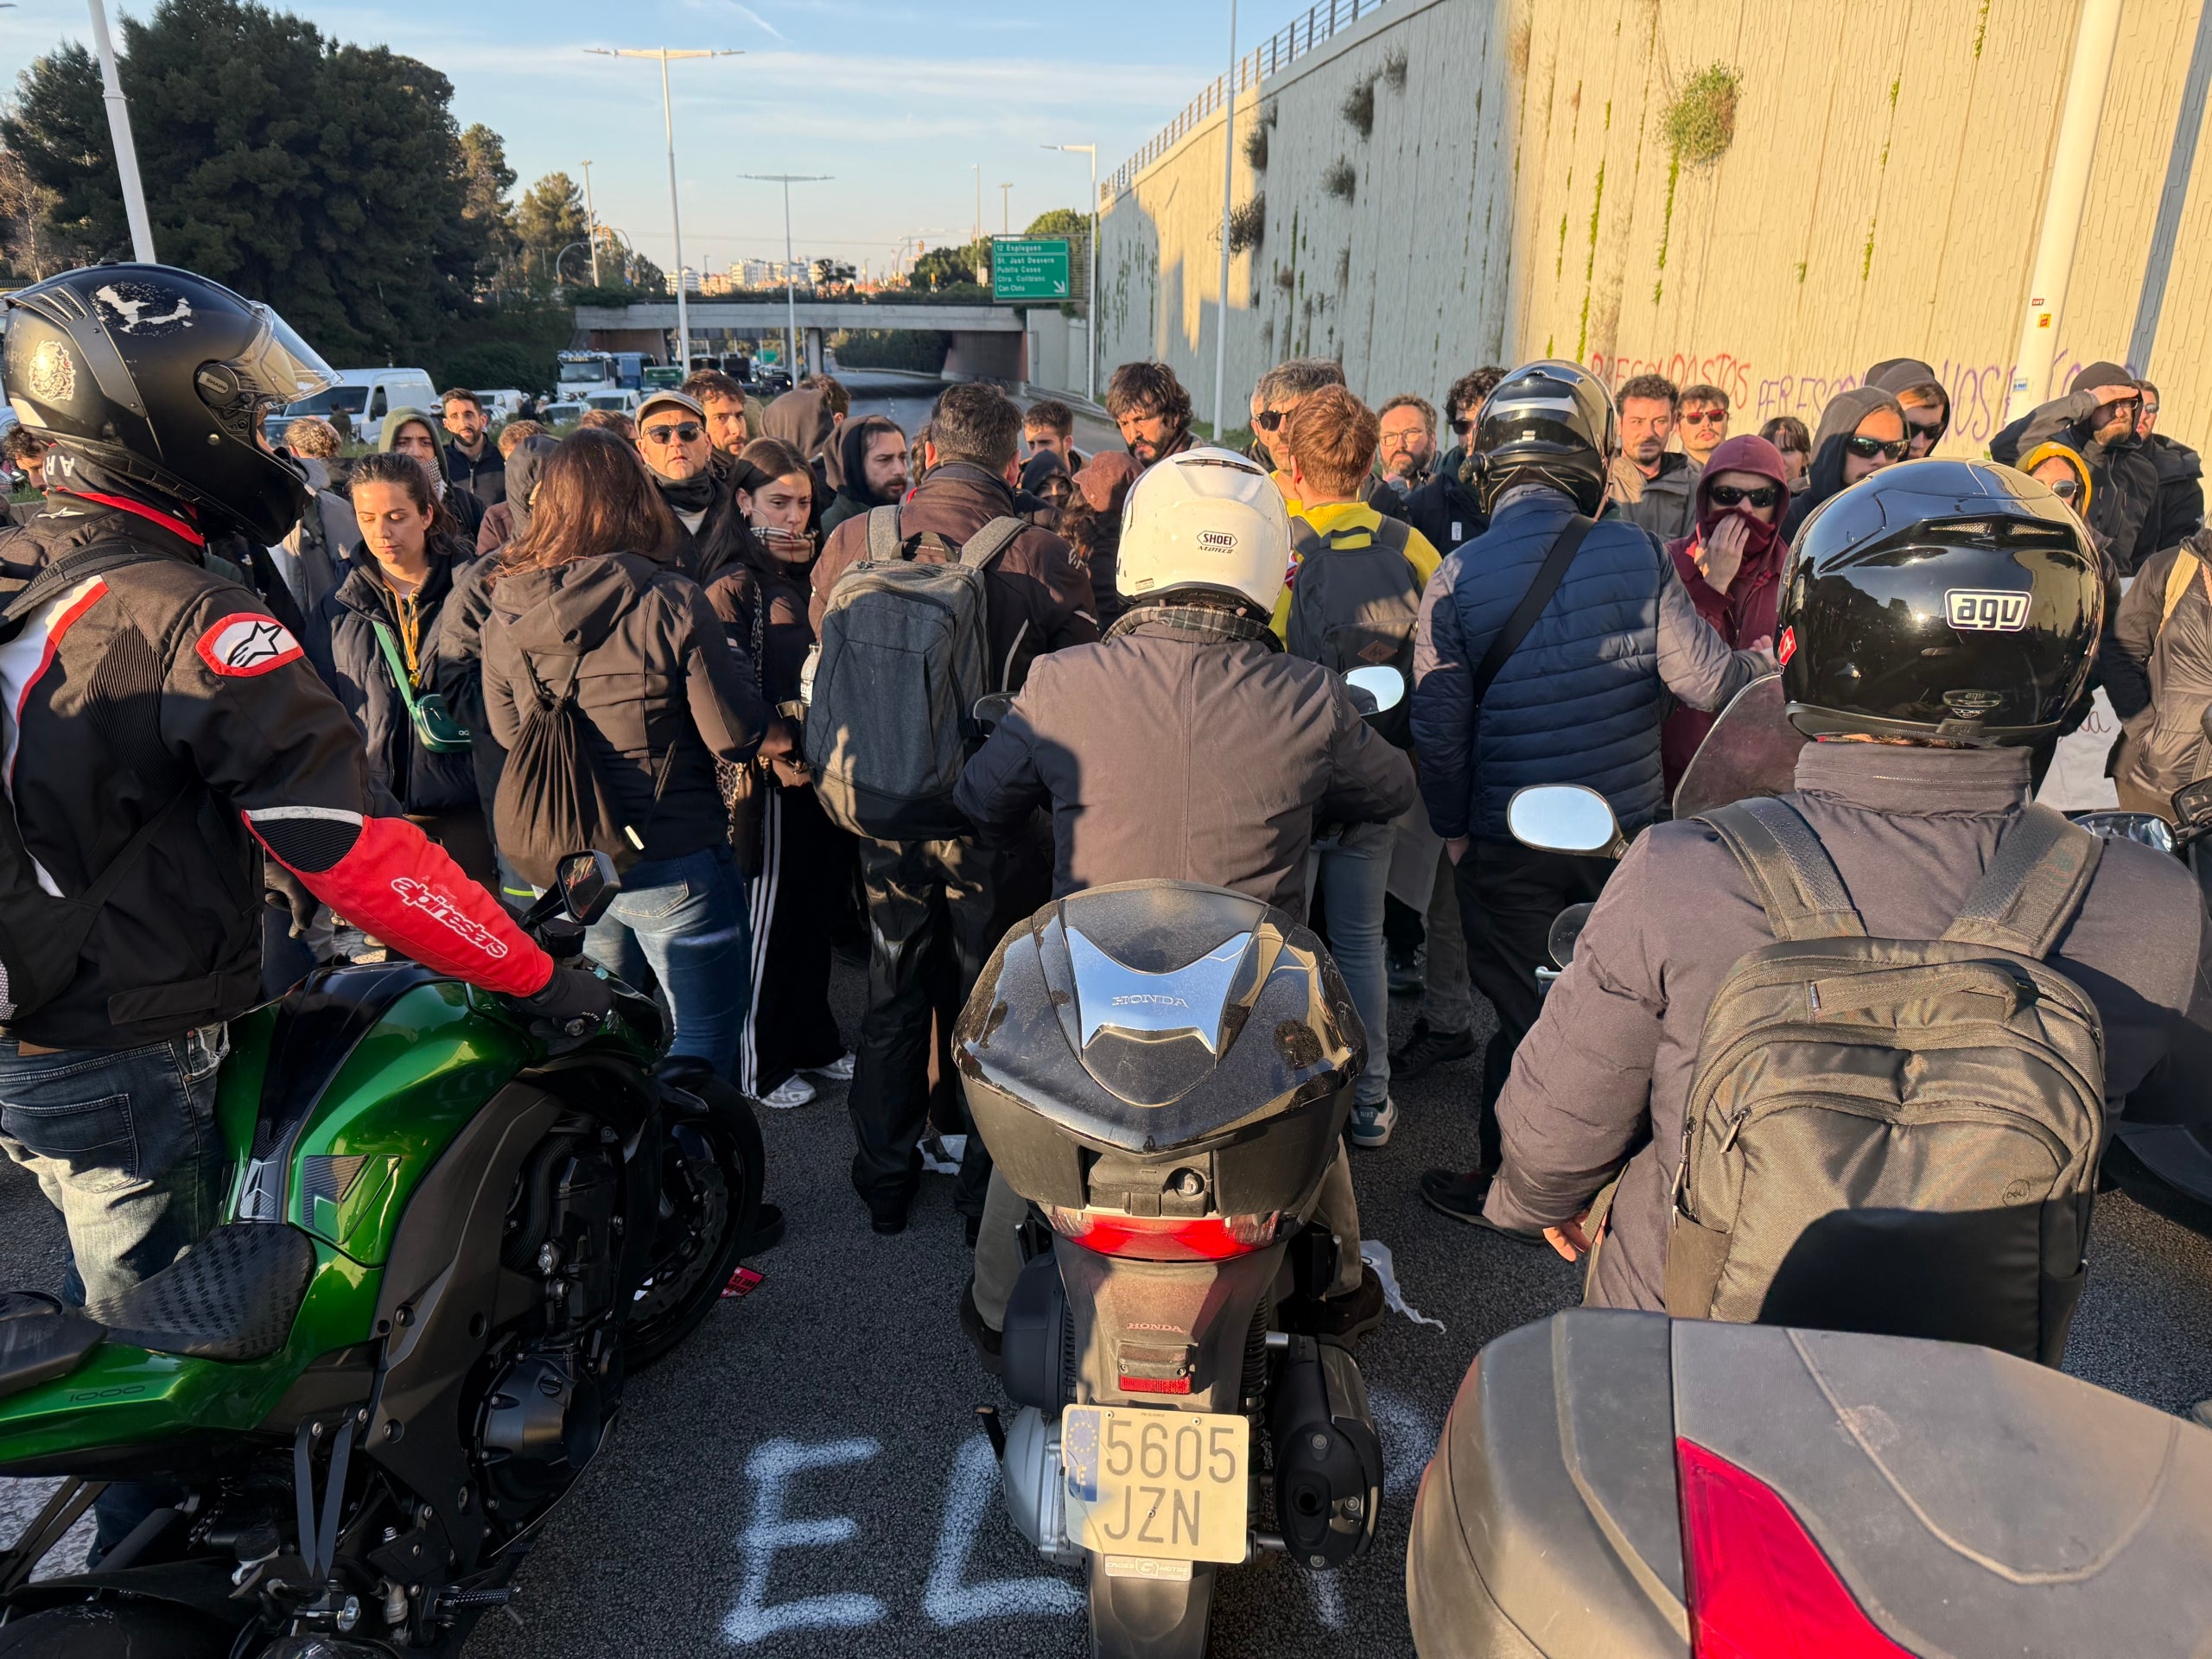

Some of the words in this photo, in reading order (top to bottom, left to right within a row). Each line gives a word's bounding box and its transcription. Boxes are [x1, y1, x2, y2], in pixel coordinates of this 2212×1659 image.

[206, 378, 228, 391] SHARK
[1203, 533, 1232, 546] SHOEI
[1956, 598, 2022, 629] agv
[1111, 994, 1190, 1008] HONDA
[1126, 1322, 1185, 1334] HONDA
[70, 1385, 145, 1402] 1000
[1106, 1420, 1236, 1484] 5605
[1103, 1484, 1201, 1547] JZN
